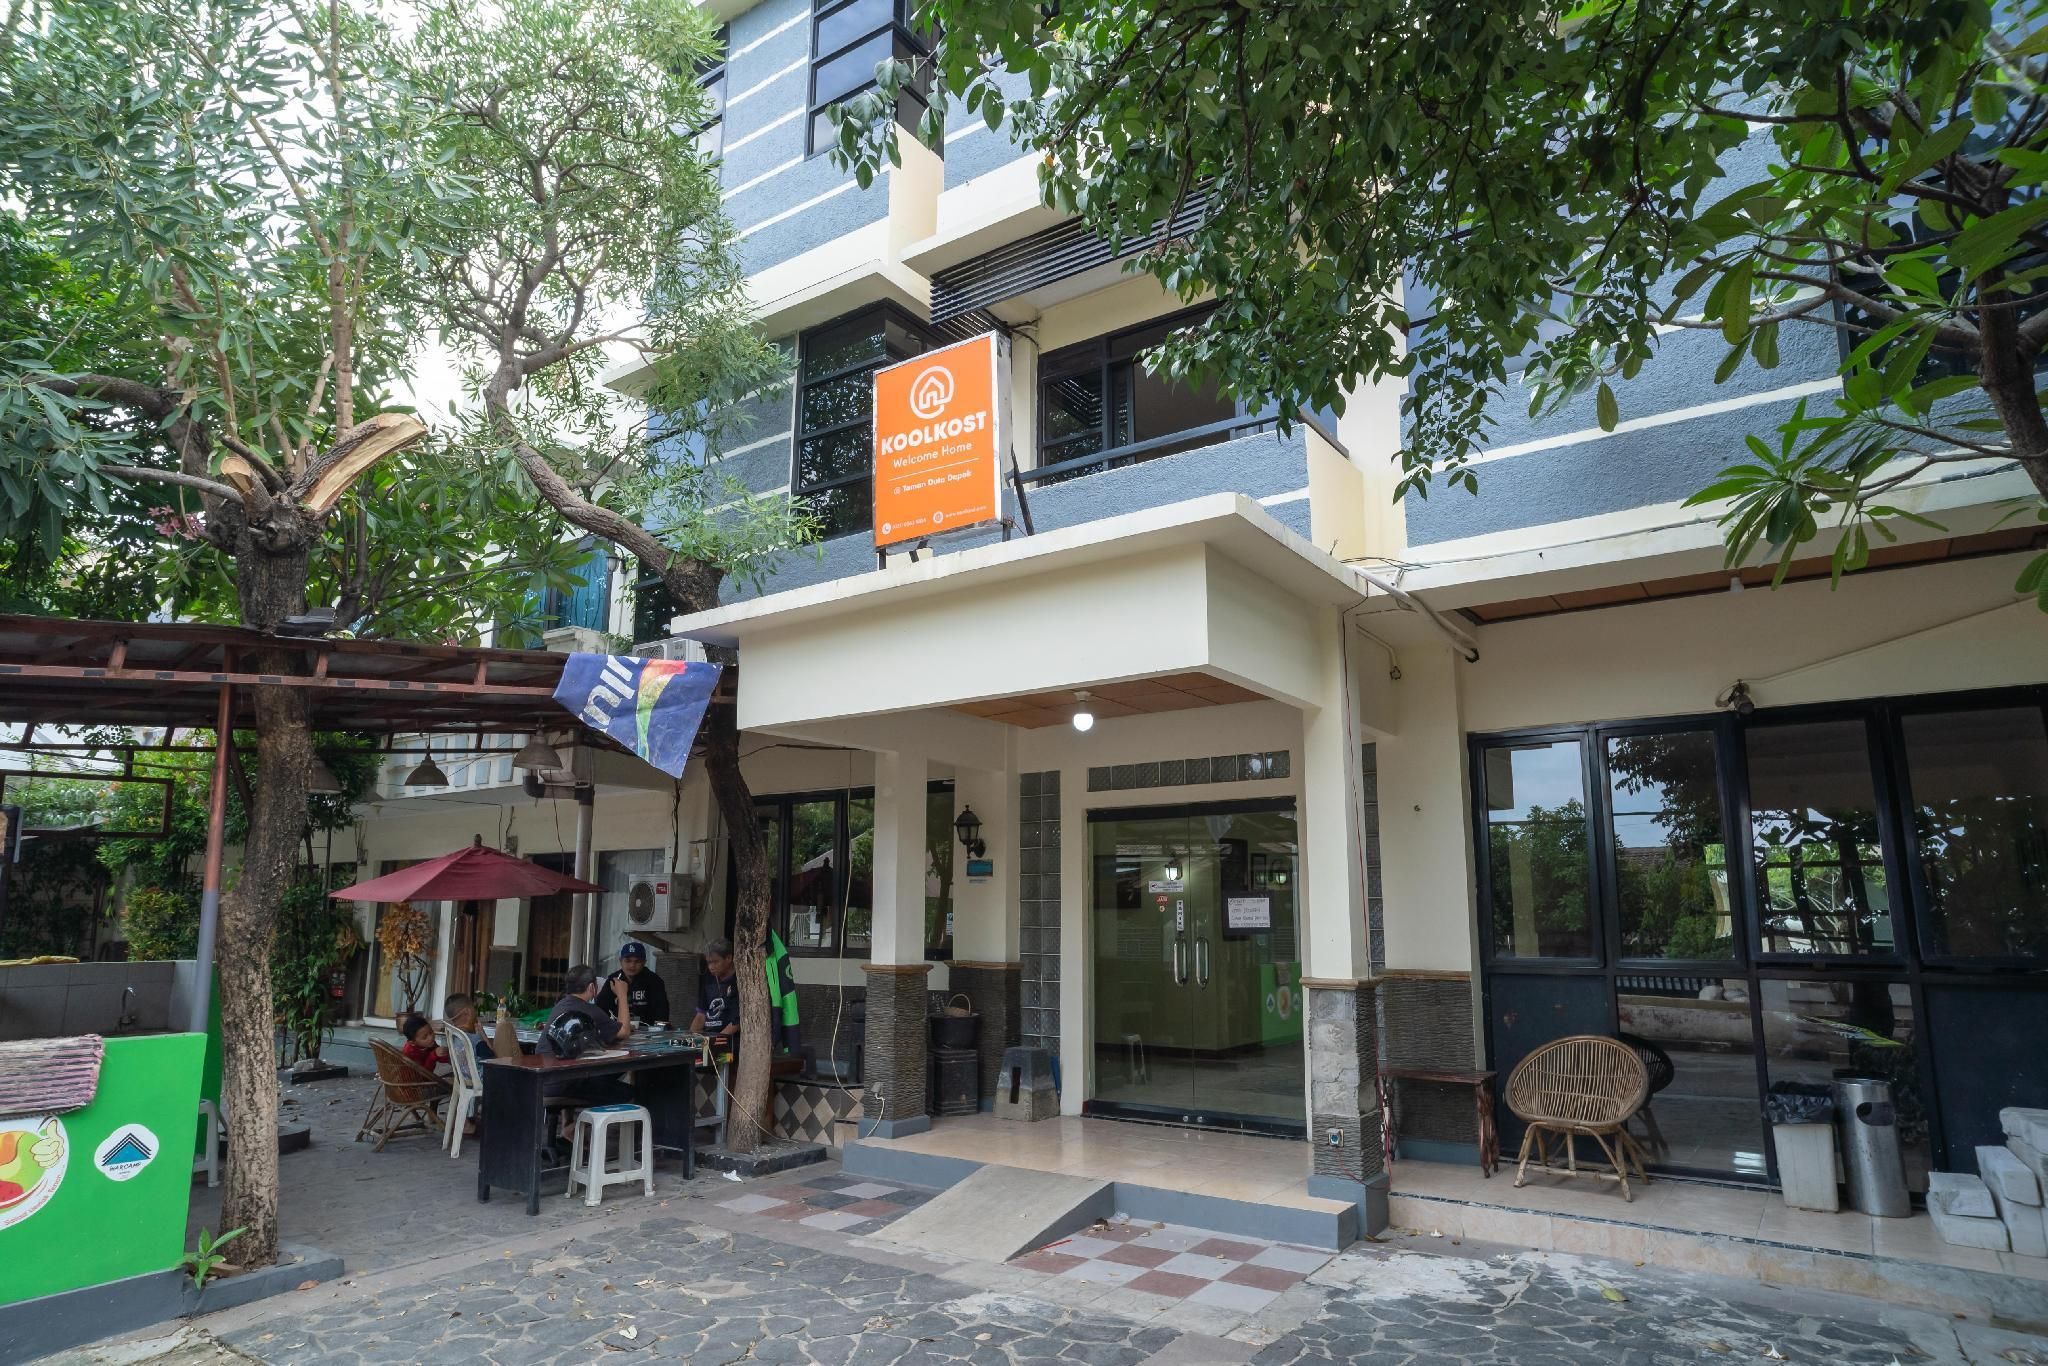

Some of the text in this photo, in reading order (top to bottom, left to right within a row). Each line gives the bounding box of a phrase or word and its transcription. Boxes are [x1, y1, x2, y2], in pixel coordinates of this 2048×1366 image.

[881, 411, 987, 456] KOOLKOST
[893, 441, 973, 468] Welcome Home
[902, 482, 926, 492] Taman
[947, 470, 972, 481] Depok
